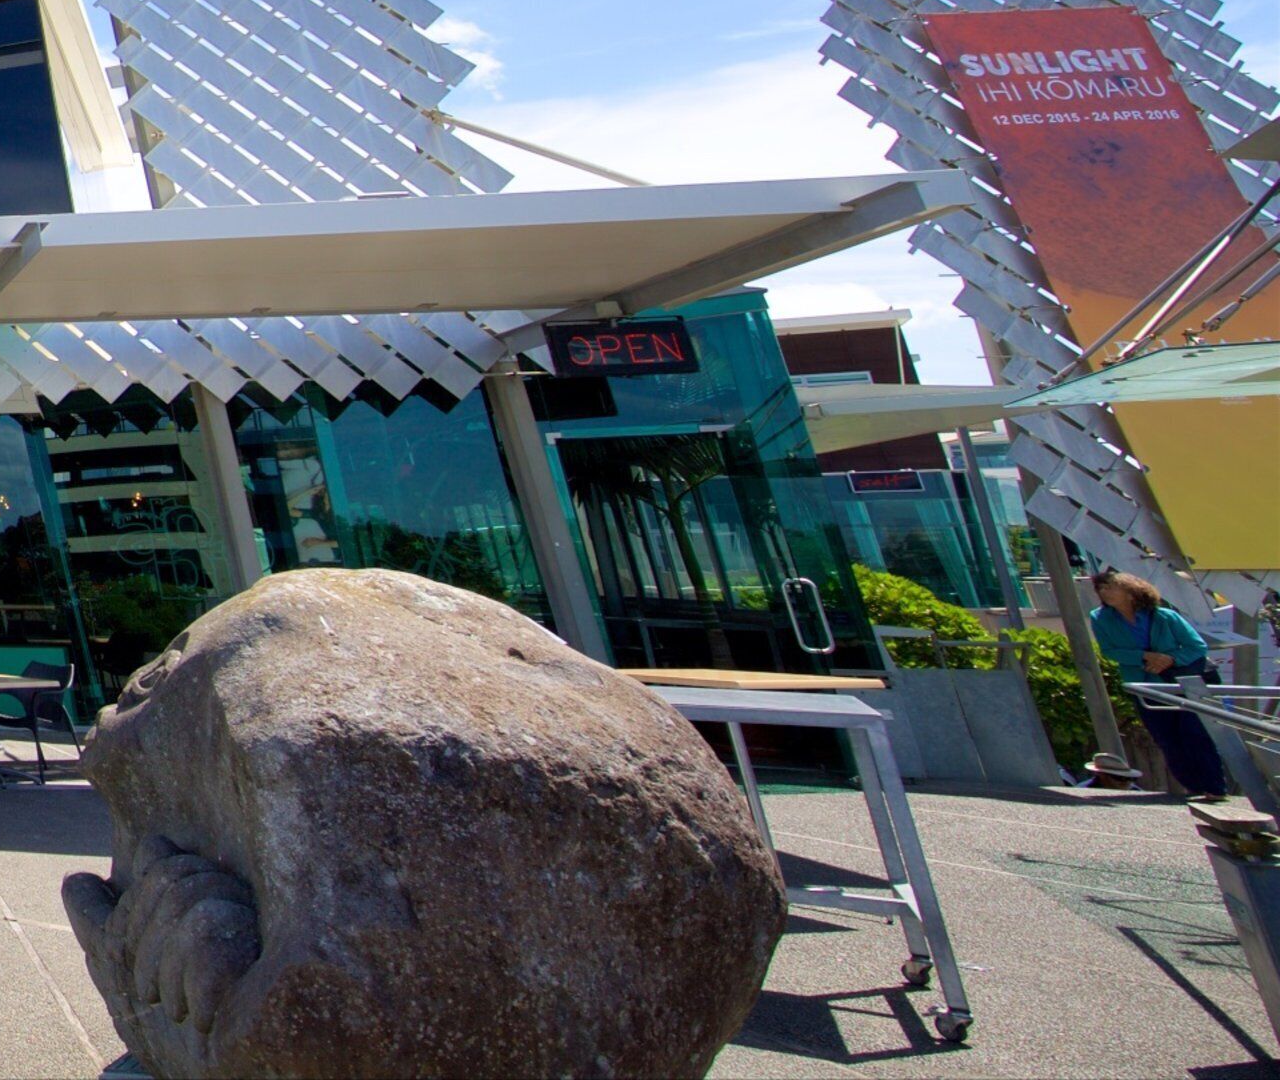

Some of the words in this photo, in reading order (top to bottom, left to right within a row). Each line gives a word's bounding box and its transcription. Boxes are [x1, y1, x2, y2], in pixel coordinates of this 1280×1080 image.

[959, 48, 1148, 77] SUNLIGHT
[976, 81, 1022, 103] IHI
[1026, 76, 1167, 101] KŌMARU
[992, 115, 1011, 126] 12
[1013, 113, 1044, 126] DEC
[1046, 112, 1080, 125] 2015
[1092, 111, 1111, 123] 24
[1113, 109, 1143, 122] APR
[1147, 108, 1180, 121] 2016
[568, 331, 686, 366] OPEN
